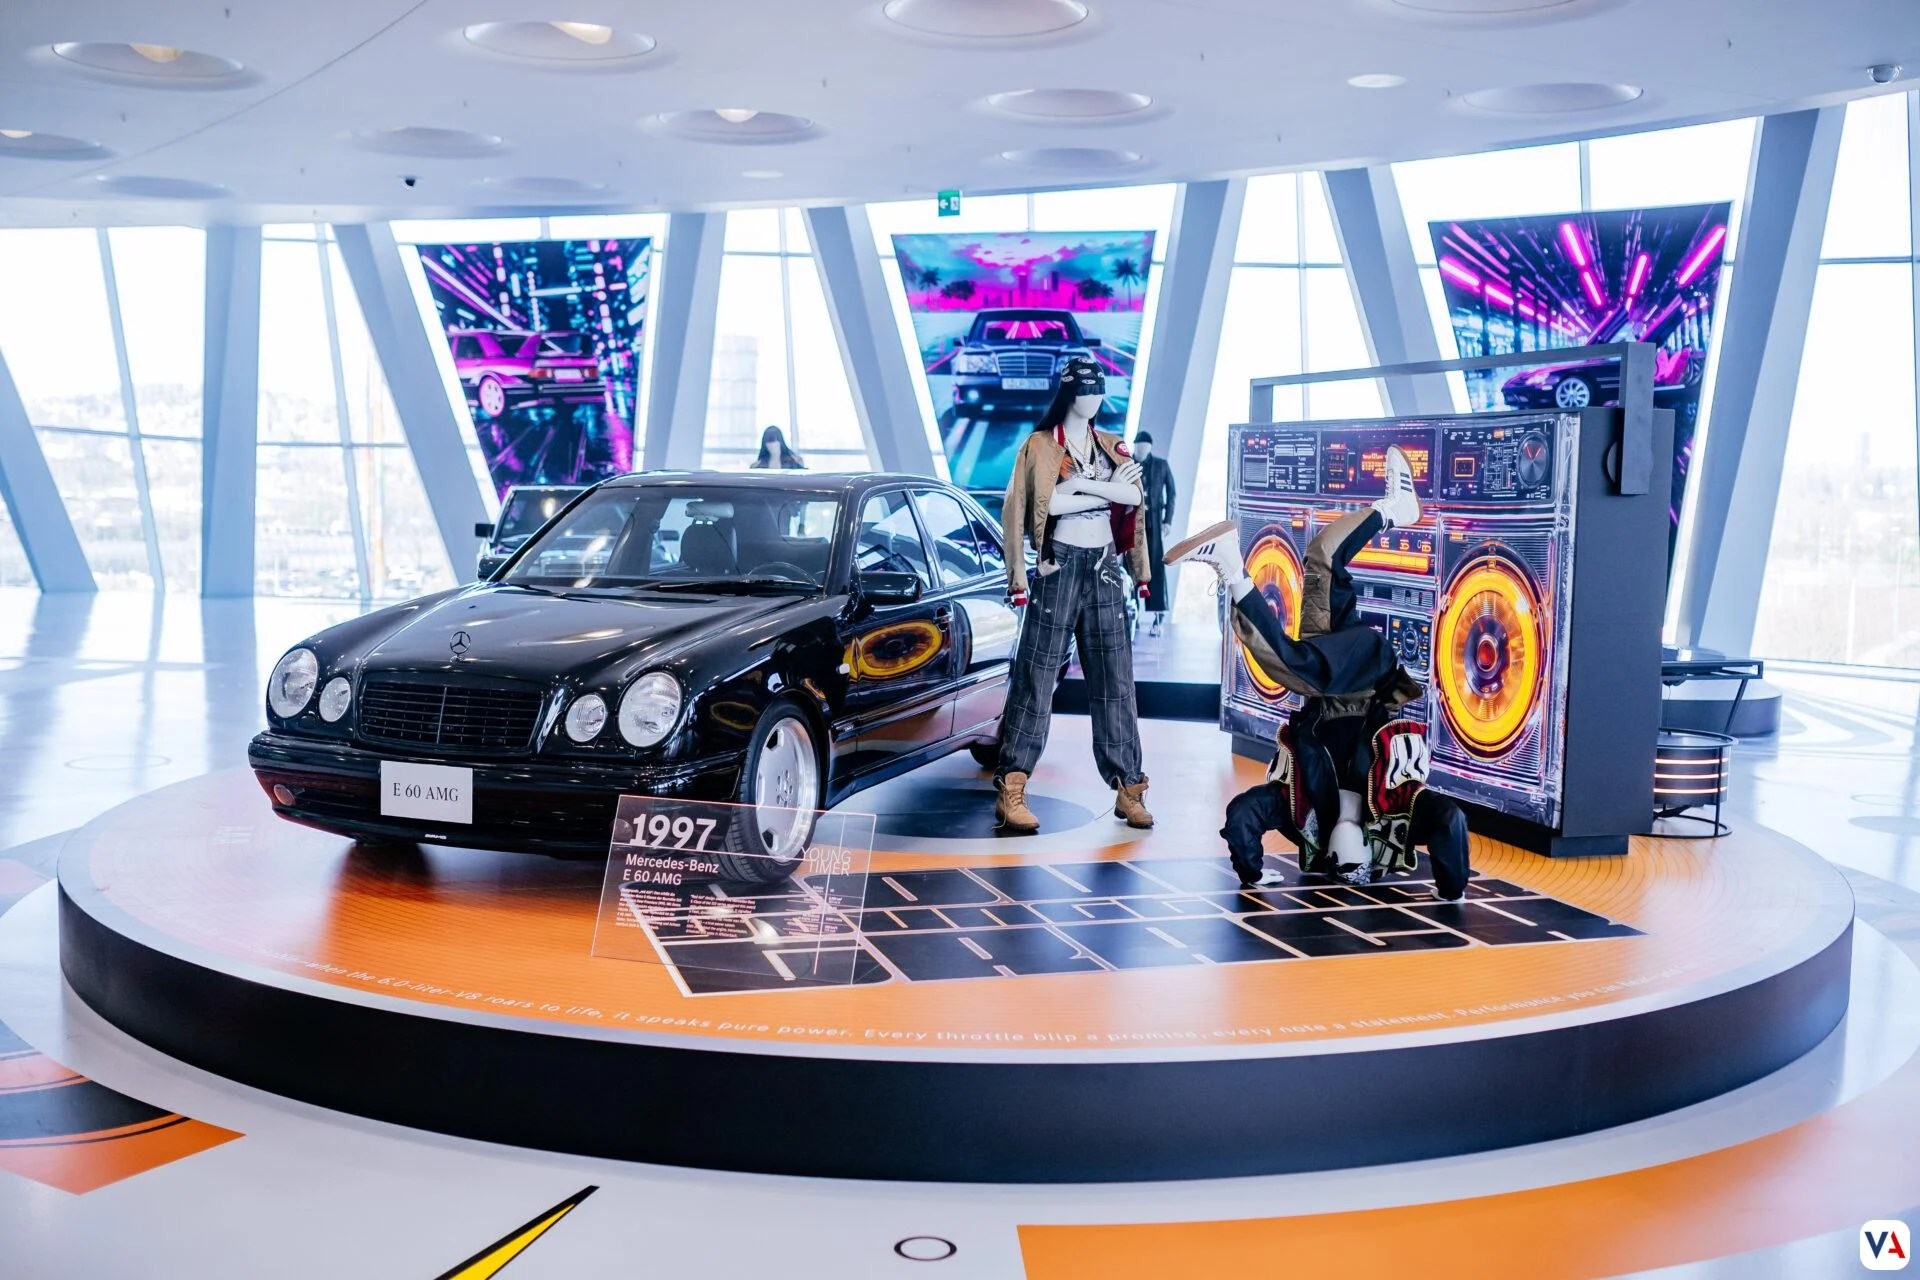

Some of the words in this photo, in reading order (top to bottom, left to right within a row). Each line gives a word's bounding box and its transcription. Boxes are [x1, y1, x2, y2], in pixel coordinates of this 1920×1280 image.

[393, 782, 402, 797] E
[405, 784, 421, 799] 60
[425, 786, 459, 802] AMG
[630, 813, 717, 851] 1997
[625, 853, 720, 874] Mercedes-Benz
[801, 846, 852, 864] YOUNG
[622, 868, 632, 881] E
[633, 870, 651, 883] 60
[652, 872, 682, 886] AMG
[808, 860, 850, 877] TIMER
[346, 970, 376, 981] the
[377, 976, 483, 1000] 6.0-liter-V8
[483, 996, 535, 1009] roars
[539, 1003, 561, 1013] to
[564, 1006, 603, 1018] life,
[614, 1011, 630, 1021] it
[635, 1015, 711, 1028] speaks
[717, 1021, 769, 1032] pure
[864, 1028, 927, 1041] Every
[937, 1031, 1023, 1042] throttle
[1033, 1031, 1077, 1043] blip
[1086, 1033, 1098, 1041] a
[1213, 1027, 1272, 1038] every
[1279, 1023, 1327, 1034] note
[1332, 1022, 1346, 1031] a
